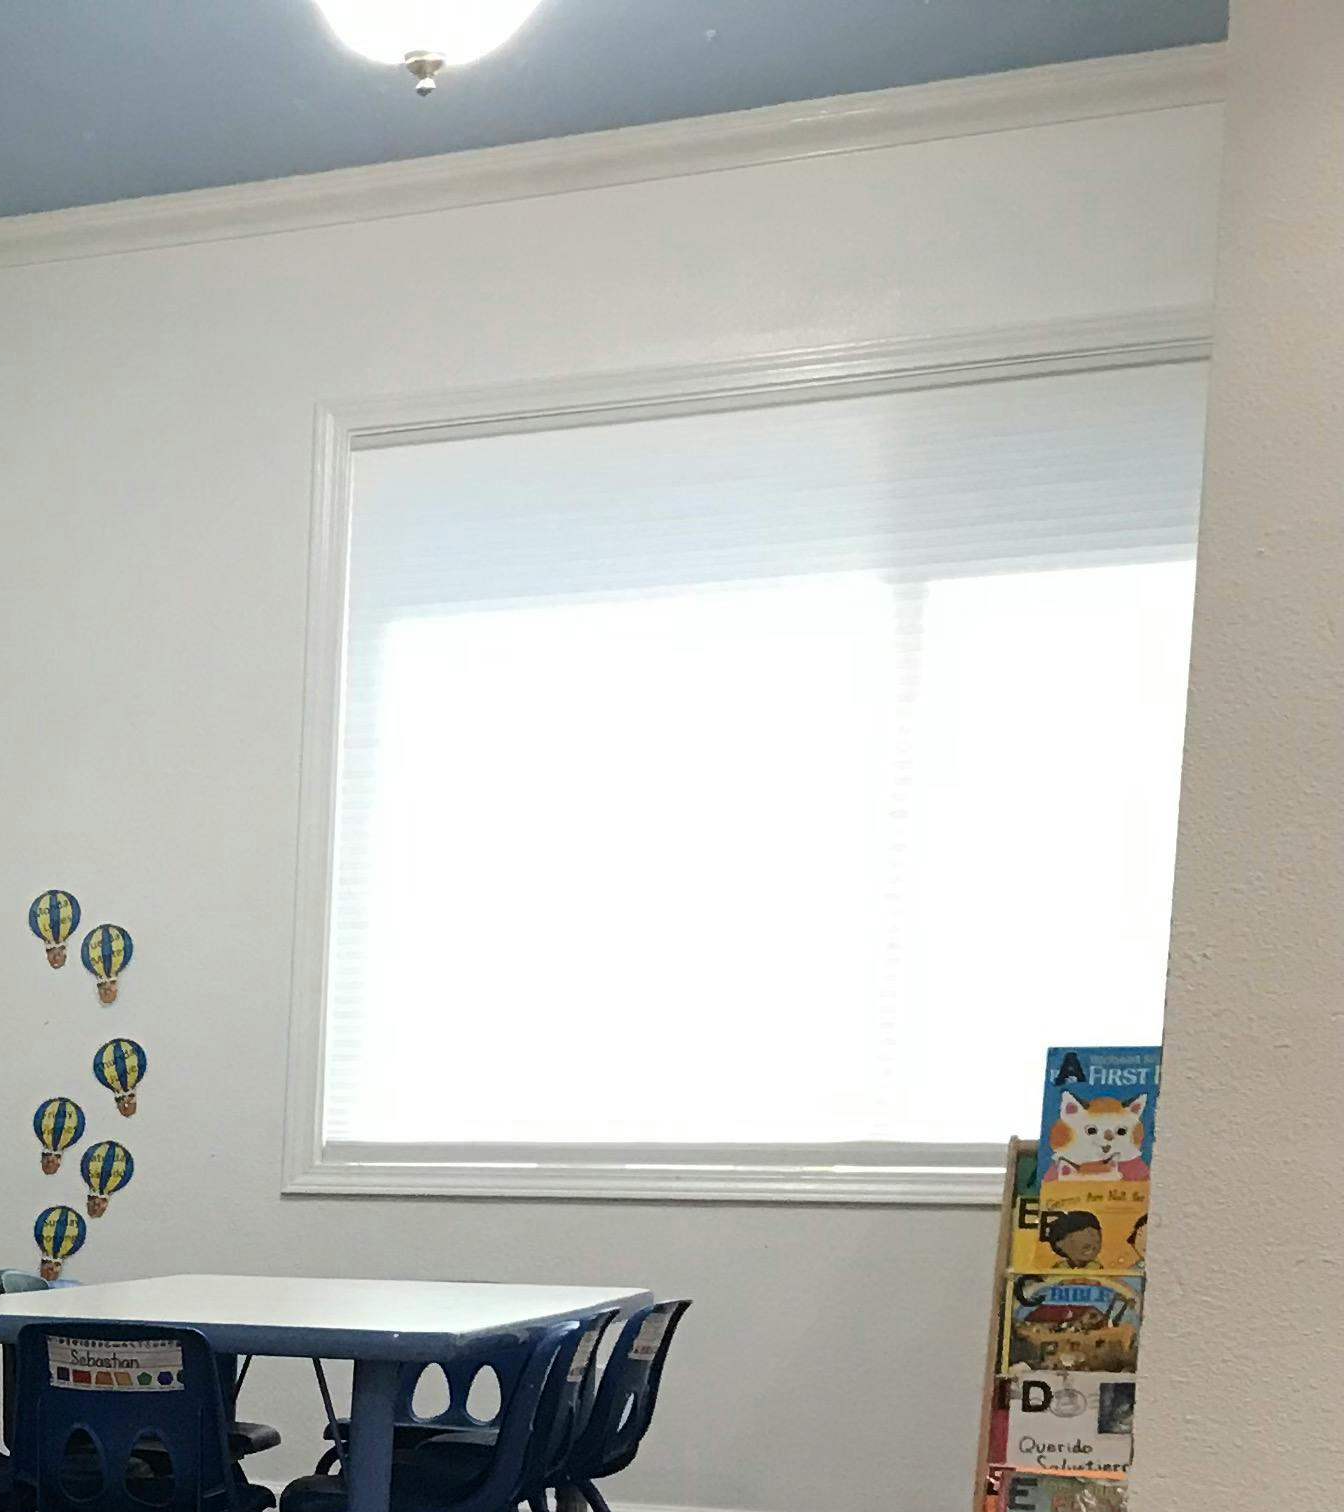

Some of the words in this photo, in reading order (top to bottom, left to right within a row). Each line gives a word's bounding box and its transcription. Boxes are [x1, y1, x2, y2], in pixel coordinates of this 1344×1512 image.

[1053, 1051, 1087, 1087] A
[1088, 1065, 1149, 1087] FIRST
[43, 1216, 80, 1231] Suday
[1014, 1274, 1047, 1307] C
[1050, 1286, 1115, 1303] BIBLE
[70, 1349, 141, 1369] Sebastian
[1022, 1379, 1054, 1412] D
[1019, 1436, 1093, 1454] Querido
[1008, 1477, 1039, 1511] E
